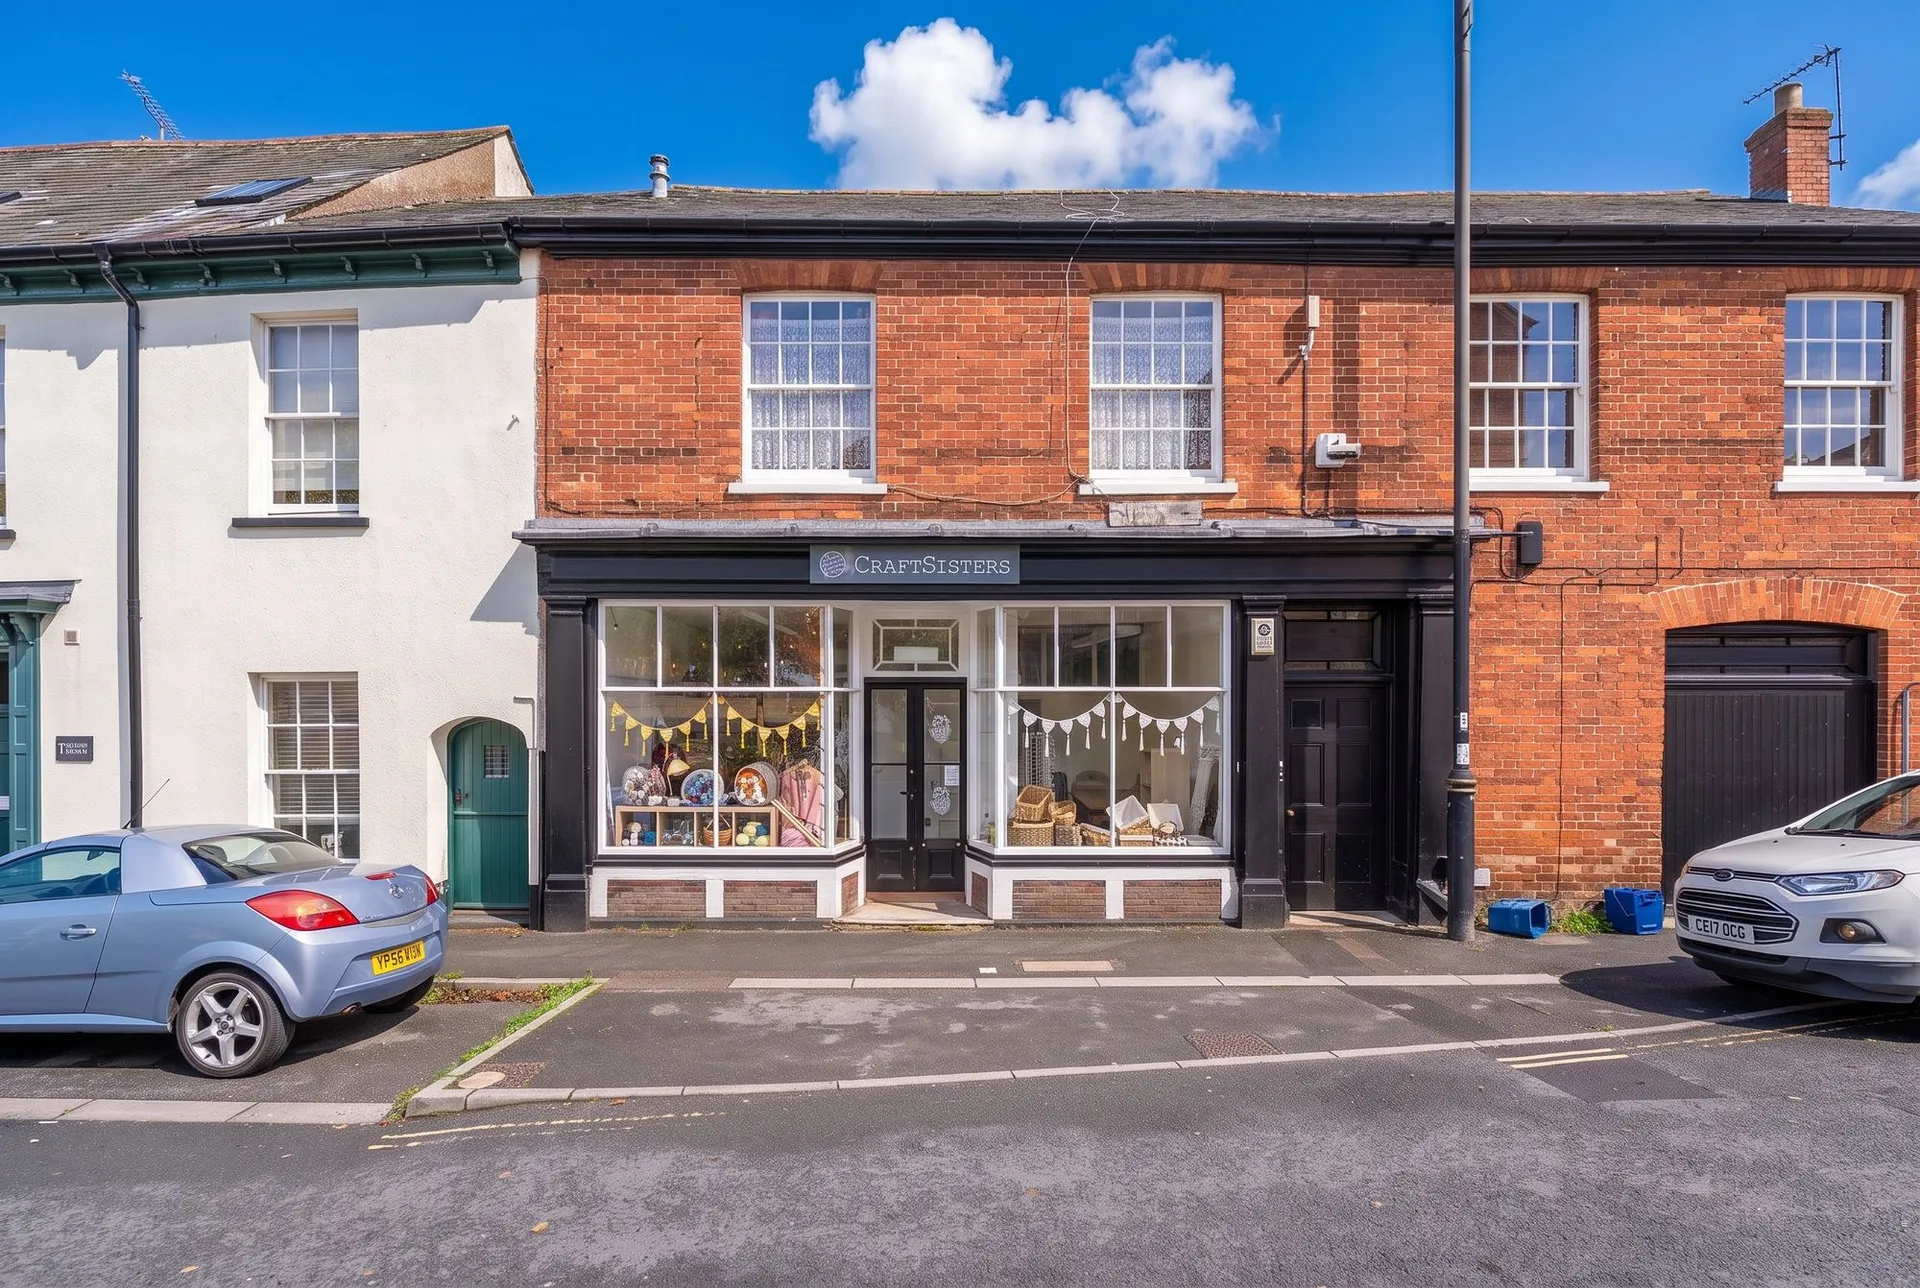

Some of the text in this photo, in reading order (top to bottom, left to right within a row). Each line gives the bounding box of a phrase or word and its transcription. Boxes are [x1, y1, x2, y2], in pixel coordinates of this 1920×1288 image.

[1695, 918, 1746, 939] CE17 OCG
[376, 949, 404, 970] YP56
